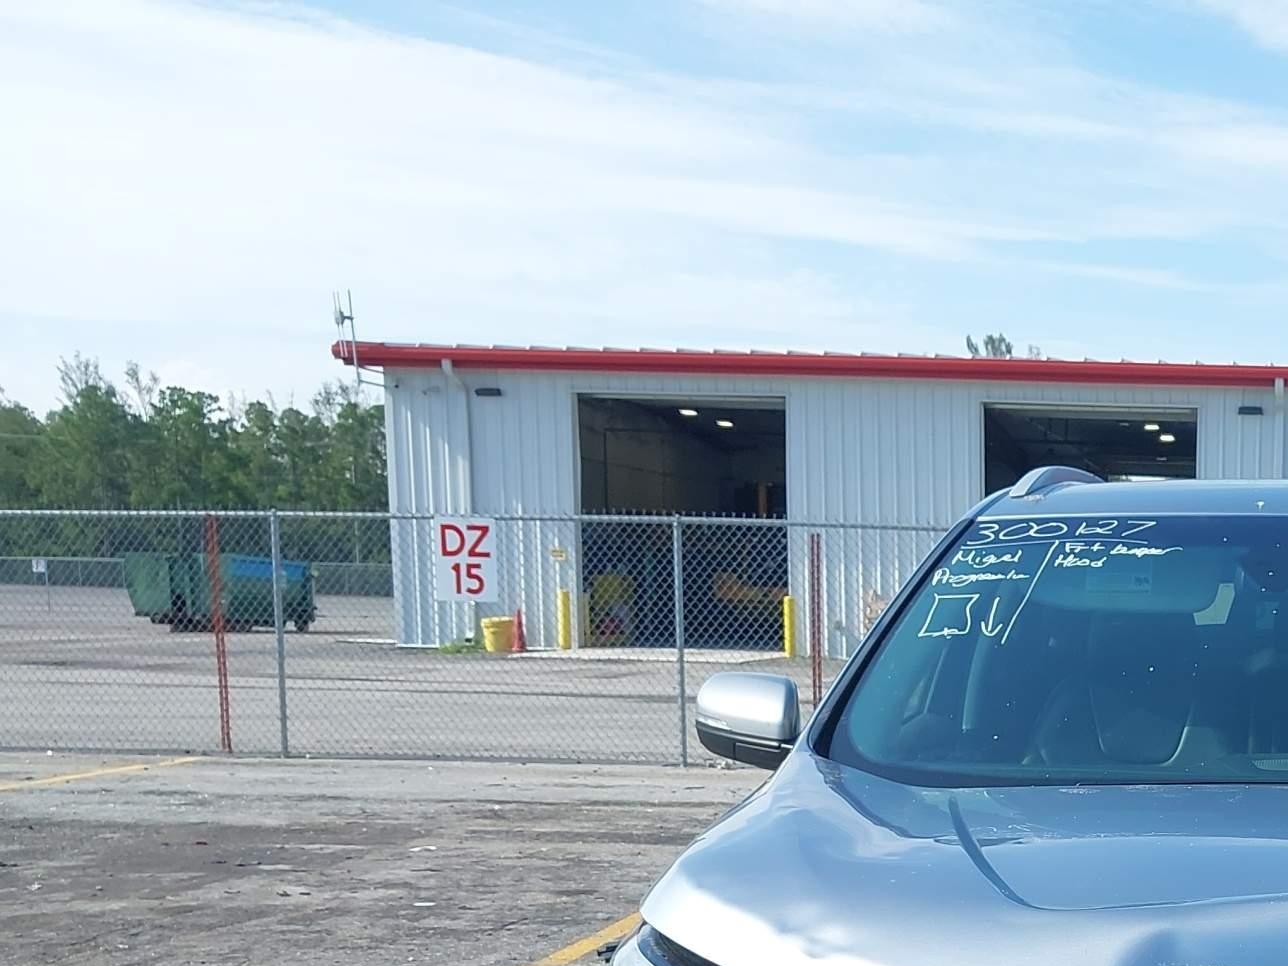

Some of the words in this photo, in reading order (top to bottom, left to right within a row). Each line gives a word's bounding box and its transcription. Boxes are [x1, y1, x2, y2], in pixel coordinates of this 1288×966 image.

[440, 524, 491, 558] DZ
[1054, 554, 1108, 568] Hood
[451, 563, 485, 595] 15
